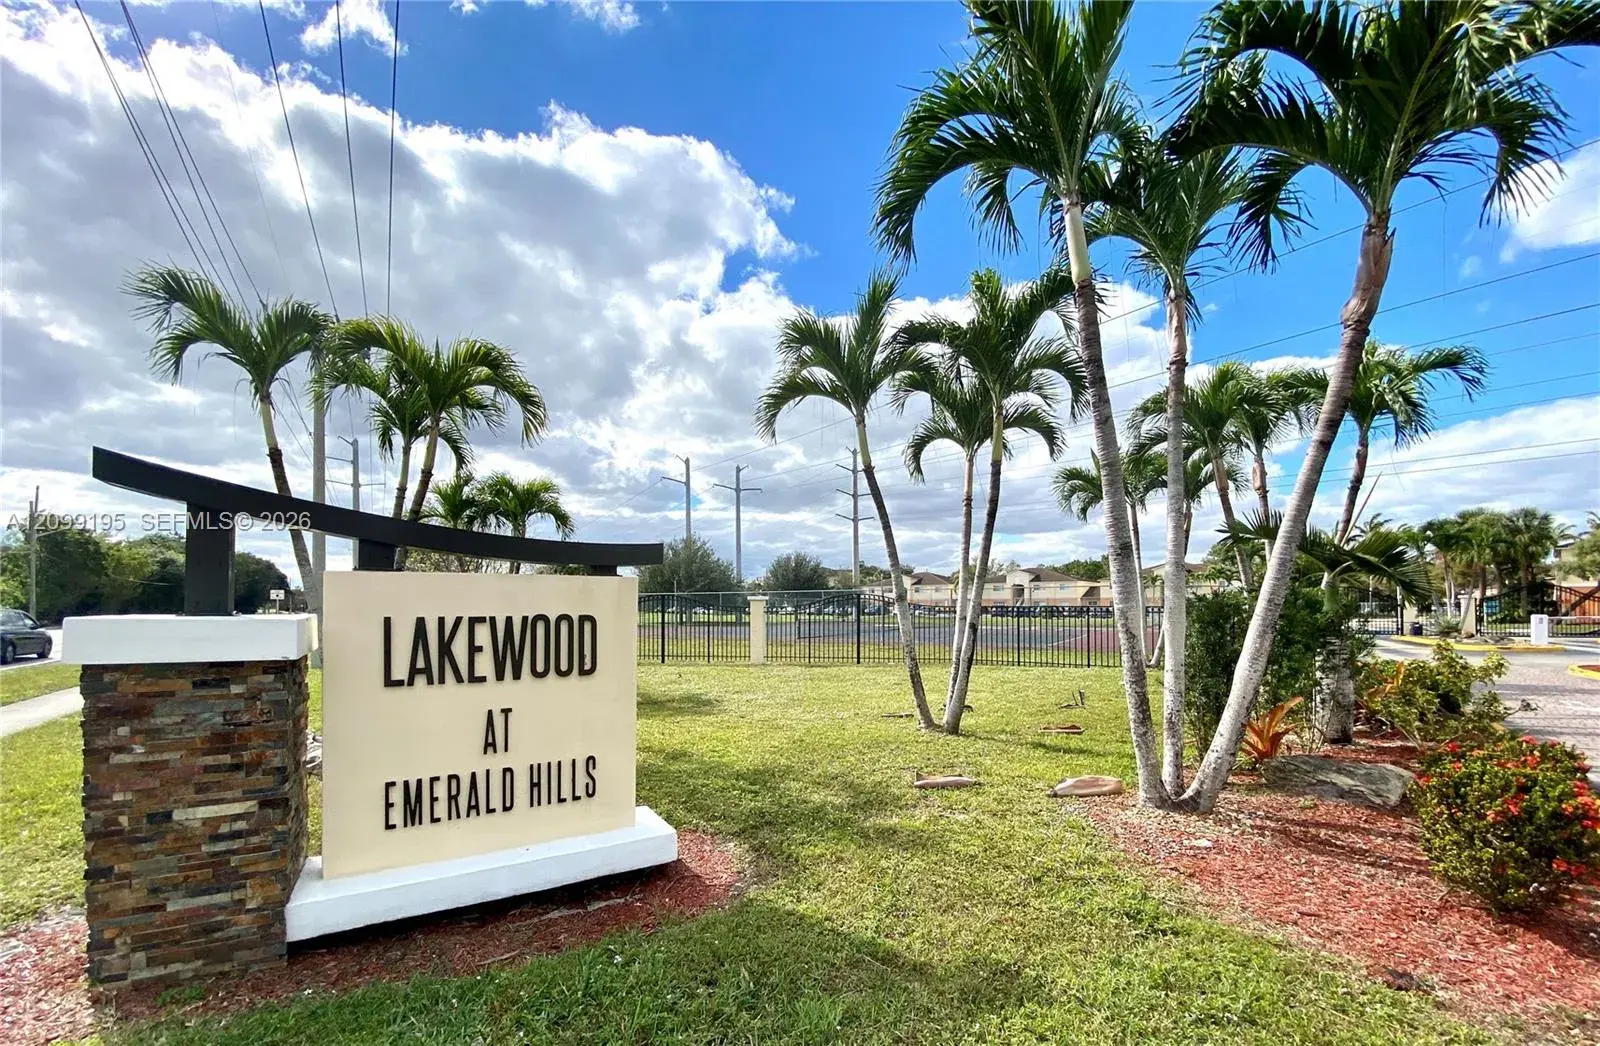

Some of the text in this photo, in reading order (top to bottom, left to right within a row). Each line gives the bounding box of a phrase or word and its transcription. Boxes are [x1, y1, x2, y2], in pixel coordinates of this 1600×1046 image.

[383, 614, 598, 688] LAKEWOOD
[483, 708, 513, 755] AT
[384, 755, 598, 831] EMERALD HILLS
